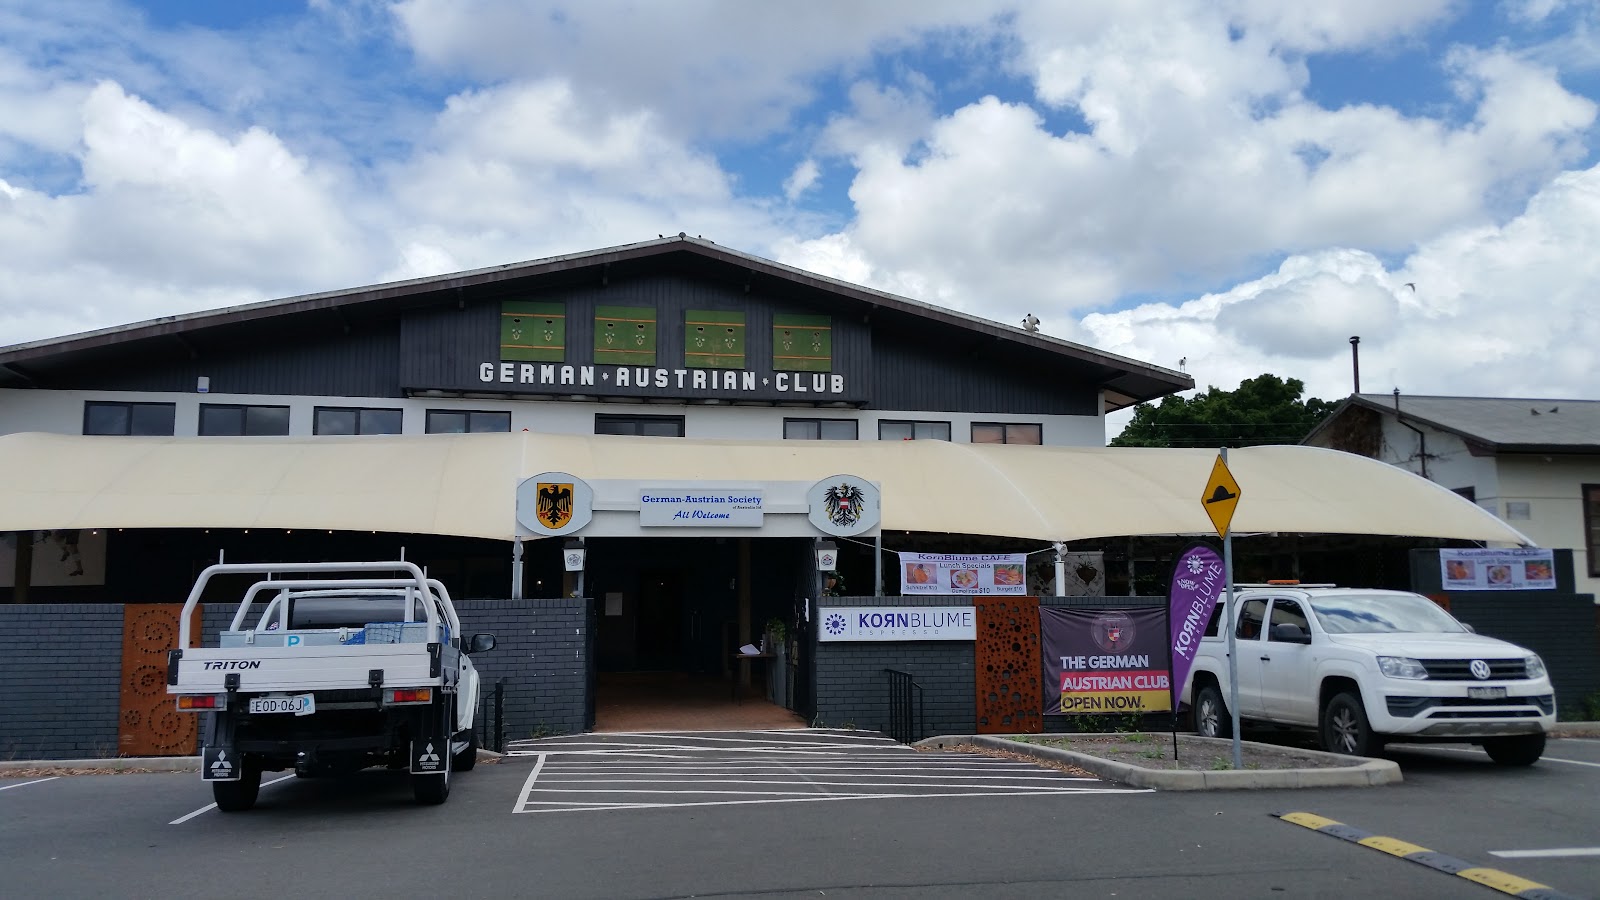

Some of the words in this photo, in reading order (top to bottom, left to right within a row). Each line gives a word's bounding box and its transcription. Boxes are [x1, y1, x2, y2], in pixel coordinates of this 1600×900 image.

[479, 362, 595, 386] GERMAN
[616, 366, 756, 391] AUSTRIAN
[775, 372, 844, 394] CLUB
[642, 495, 725, 503] German-Austrian
[727, 495, 762, 505] Society
[673, 510, 690, 521] All
[691, 510, 730, 519] Welcome
[918, 553, 979, 561] KornBlume
[961, 562, 991, 570] Specials
[1180, 578, 1196, 586] NOW
[1180, 583, 1195, 591] OPEN
[203, 660, 261, 671] TRITON
[1060, 655, 1086, 669] THE
[1088, 654, 1149, 669] GERMAN
[1062, 675, 1132, 691] AUSTRIAN
[1134, 675, 1169, 689] CLUB
[1061, 697, 1102, 710] OPEN
[1104, 696, 1146, 709] NOW.
